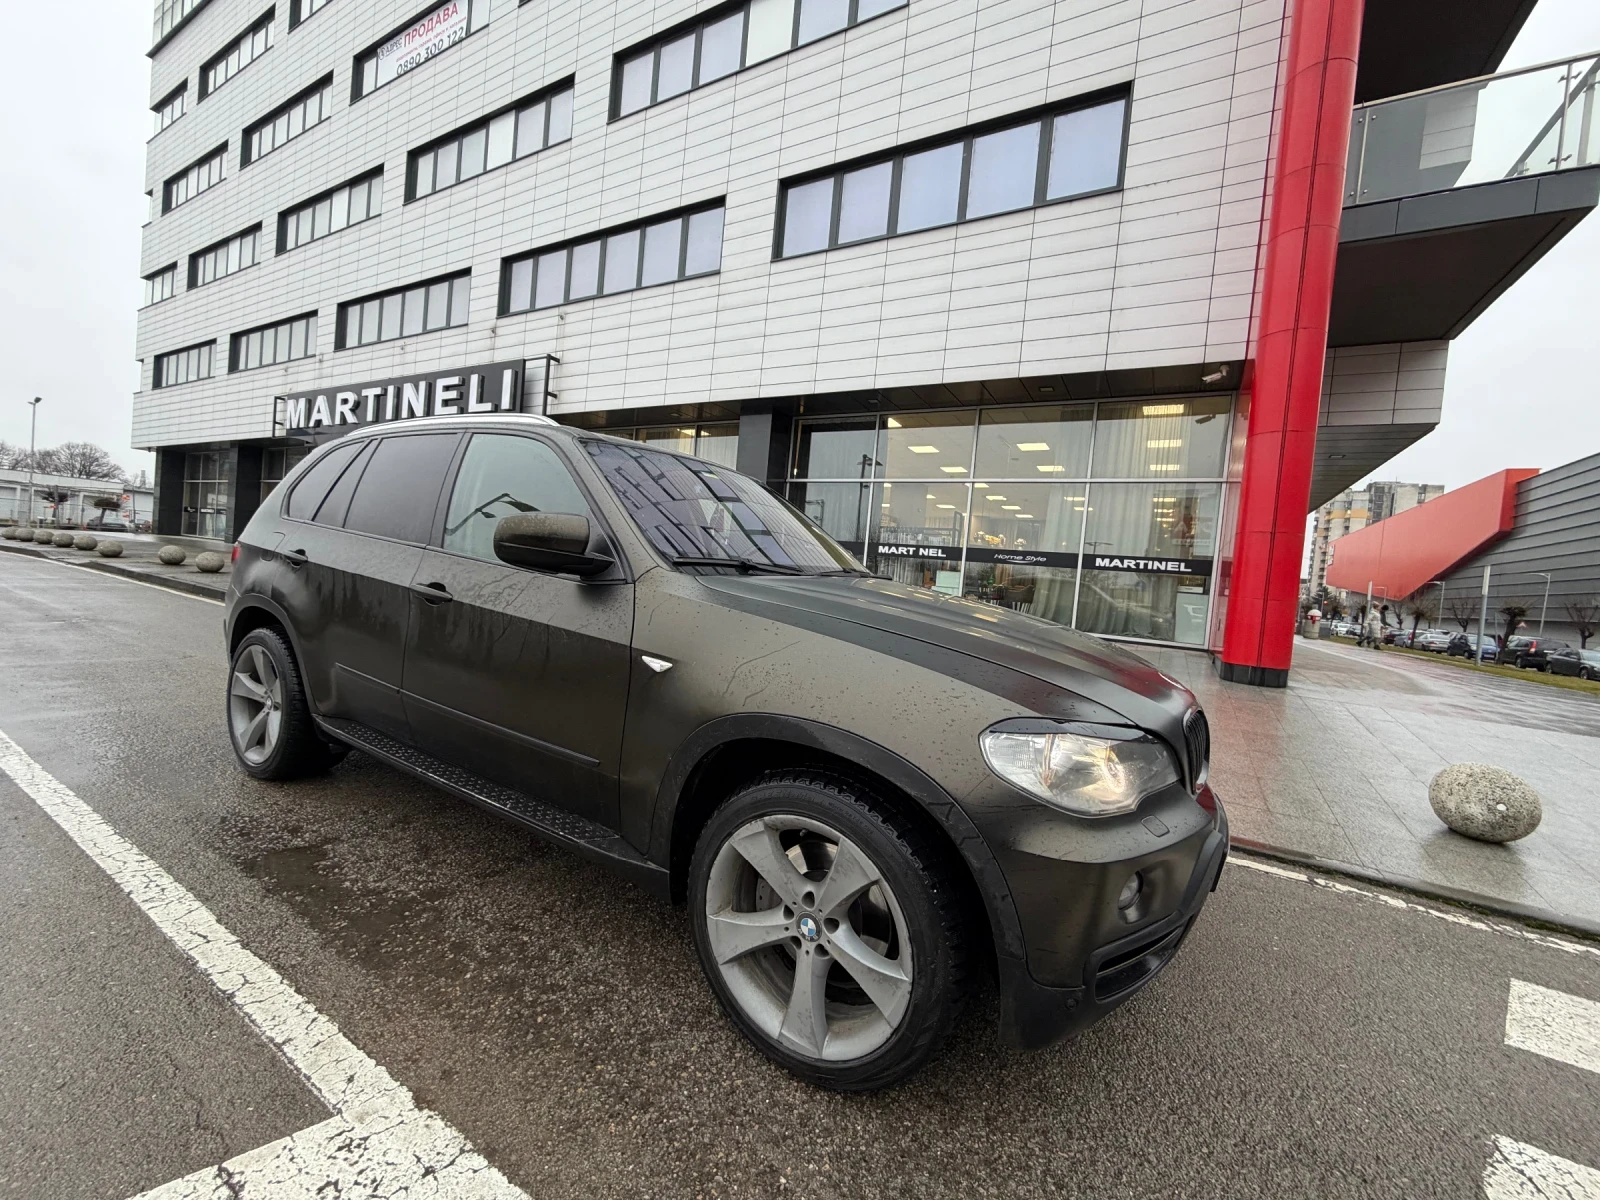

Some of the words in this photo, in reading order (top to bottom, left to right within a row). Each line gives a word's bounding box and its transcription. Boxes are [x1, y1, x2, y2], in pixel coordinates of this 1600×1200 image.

[404, 2, 458, 47] ПРОДАВА
[396, 53, 421, 76] 0890
[424, 39, 444, 60] 300
[447, 26, 464, 47] 122
[286, 369, 517, 429] MARTINELI
[1095, 557, 1192, 572] MARTINEL
